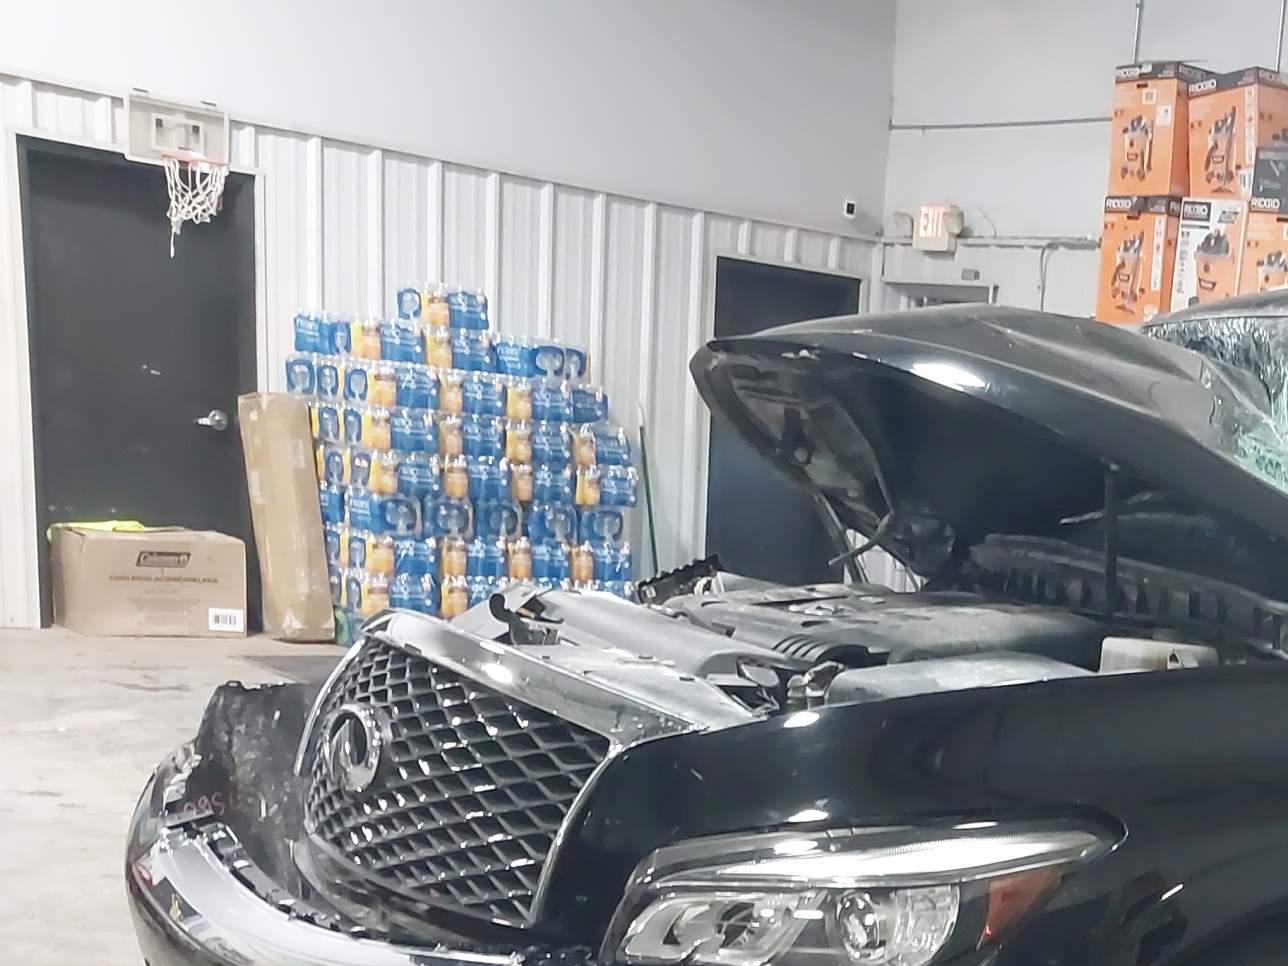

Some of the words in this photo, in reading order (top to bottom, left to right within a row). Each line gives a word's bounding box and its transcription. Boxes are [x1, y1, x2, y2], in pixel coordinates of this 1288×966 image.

[1188, 79, 1217, 96] RIDGID
[1105, 198, 1133, 209] RIDGID
[1252, 198, 1280, 210] RIDGID
[919, 206, 946, 237] EXIT
